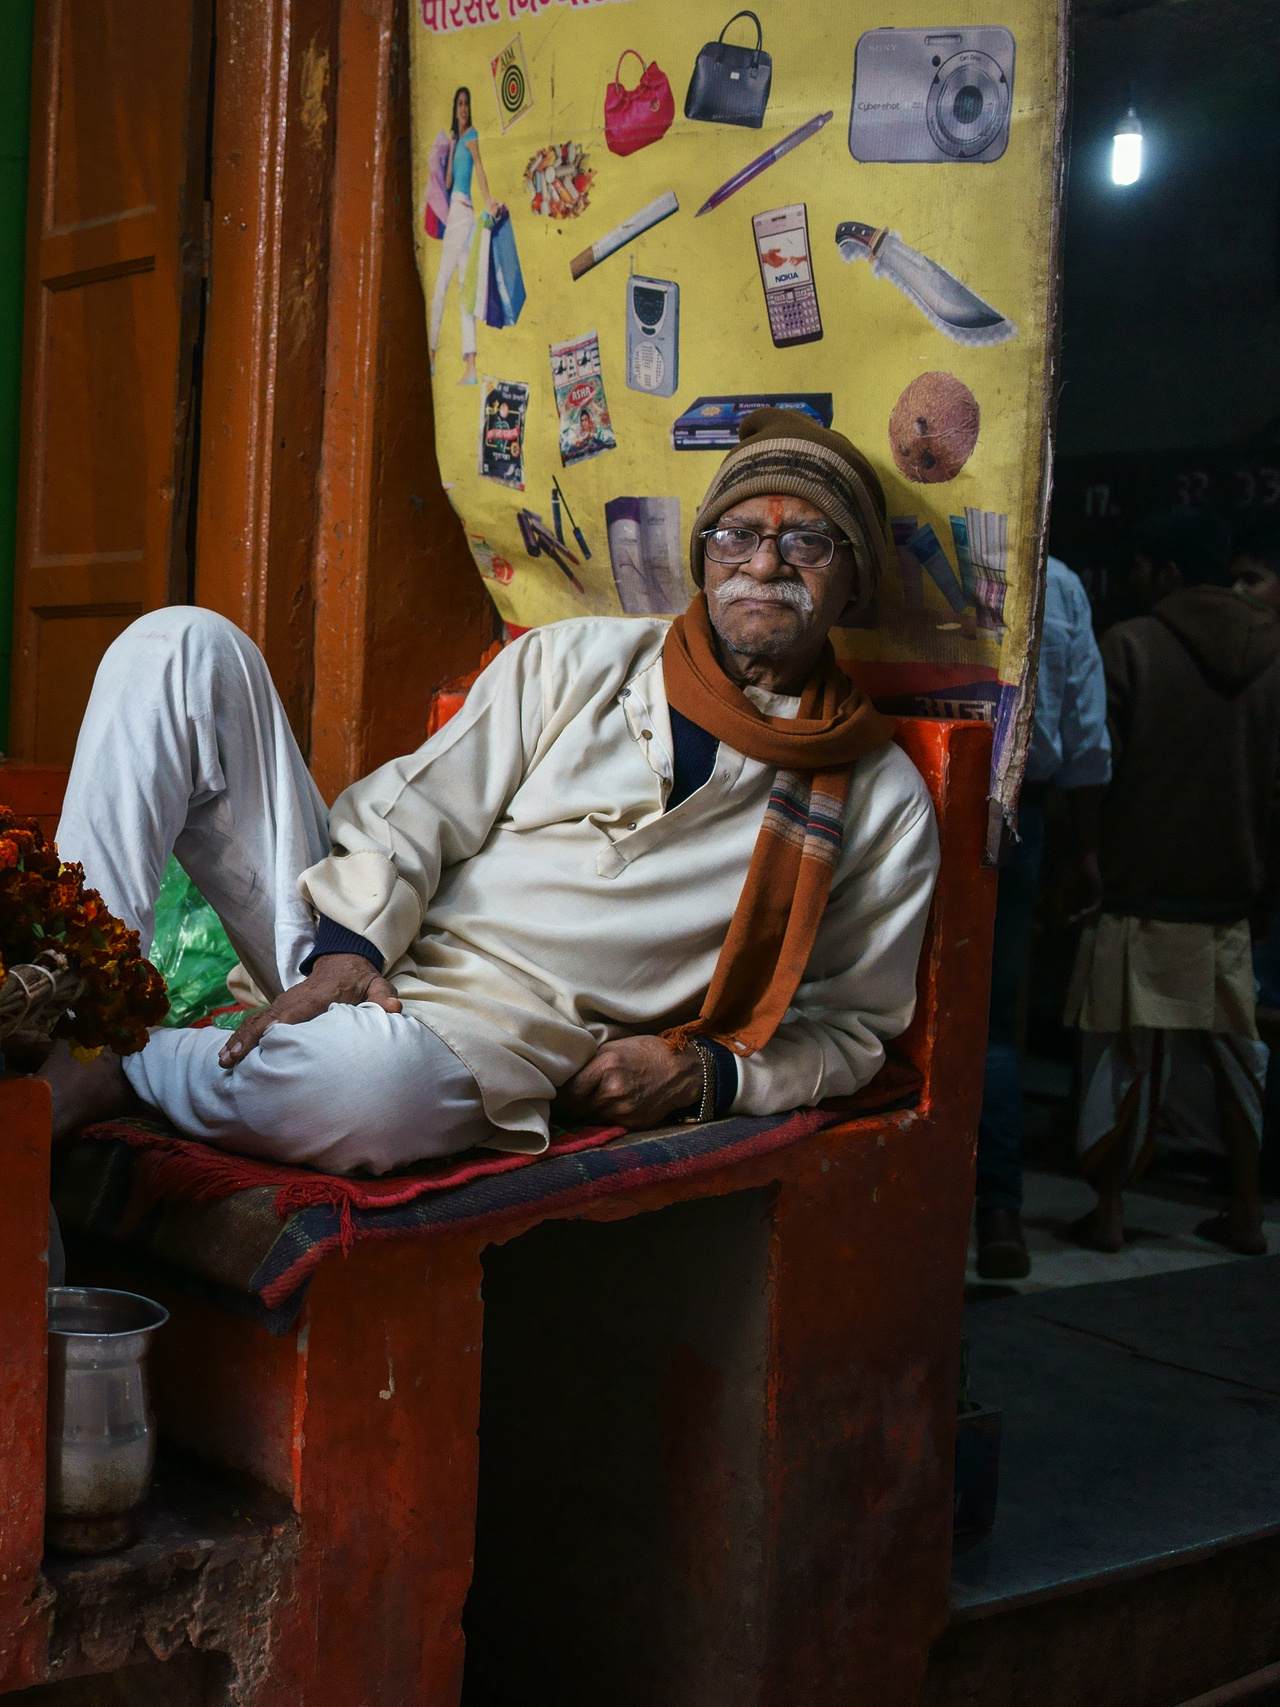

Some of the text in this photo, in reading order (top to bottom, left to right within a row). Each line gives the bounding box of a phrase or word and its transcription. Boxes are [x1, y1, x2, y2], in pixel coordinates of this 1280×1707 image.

[501, 46, 516, 72] AIM
[775, 272, 799, 283] NOKIA
[571, 386, 590, 401] ASHA
